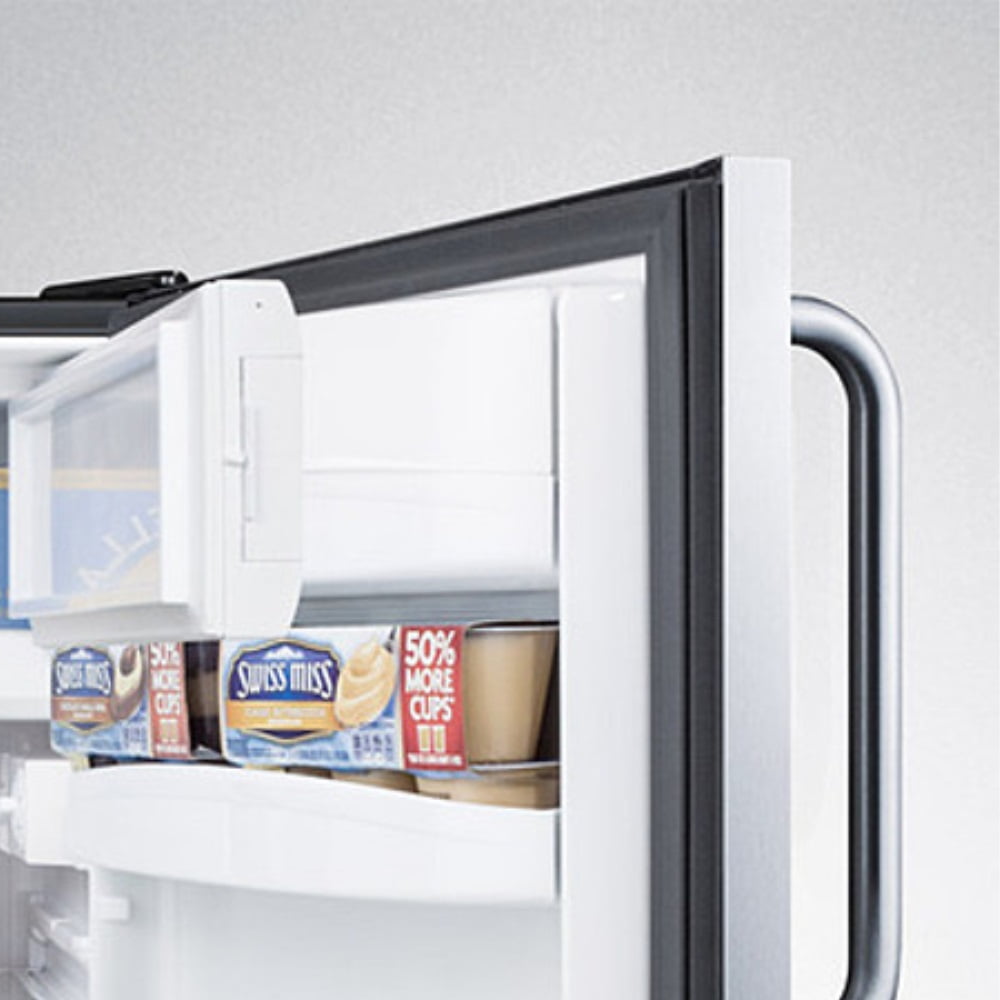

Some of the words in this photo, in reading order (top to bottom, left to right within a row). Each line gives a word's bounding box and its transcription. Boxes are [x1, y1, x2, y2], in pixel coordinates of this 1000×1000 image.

[404, 629, 456, 666] 50%
[151, 668, 180, 690] MORE
[404, 667, 455, 693] MORE
